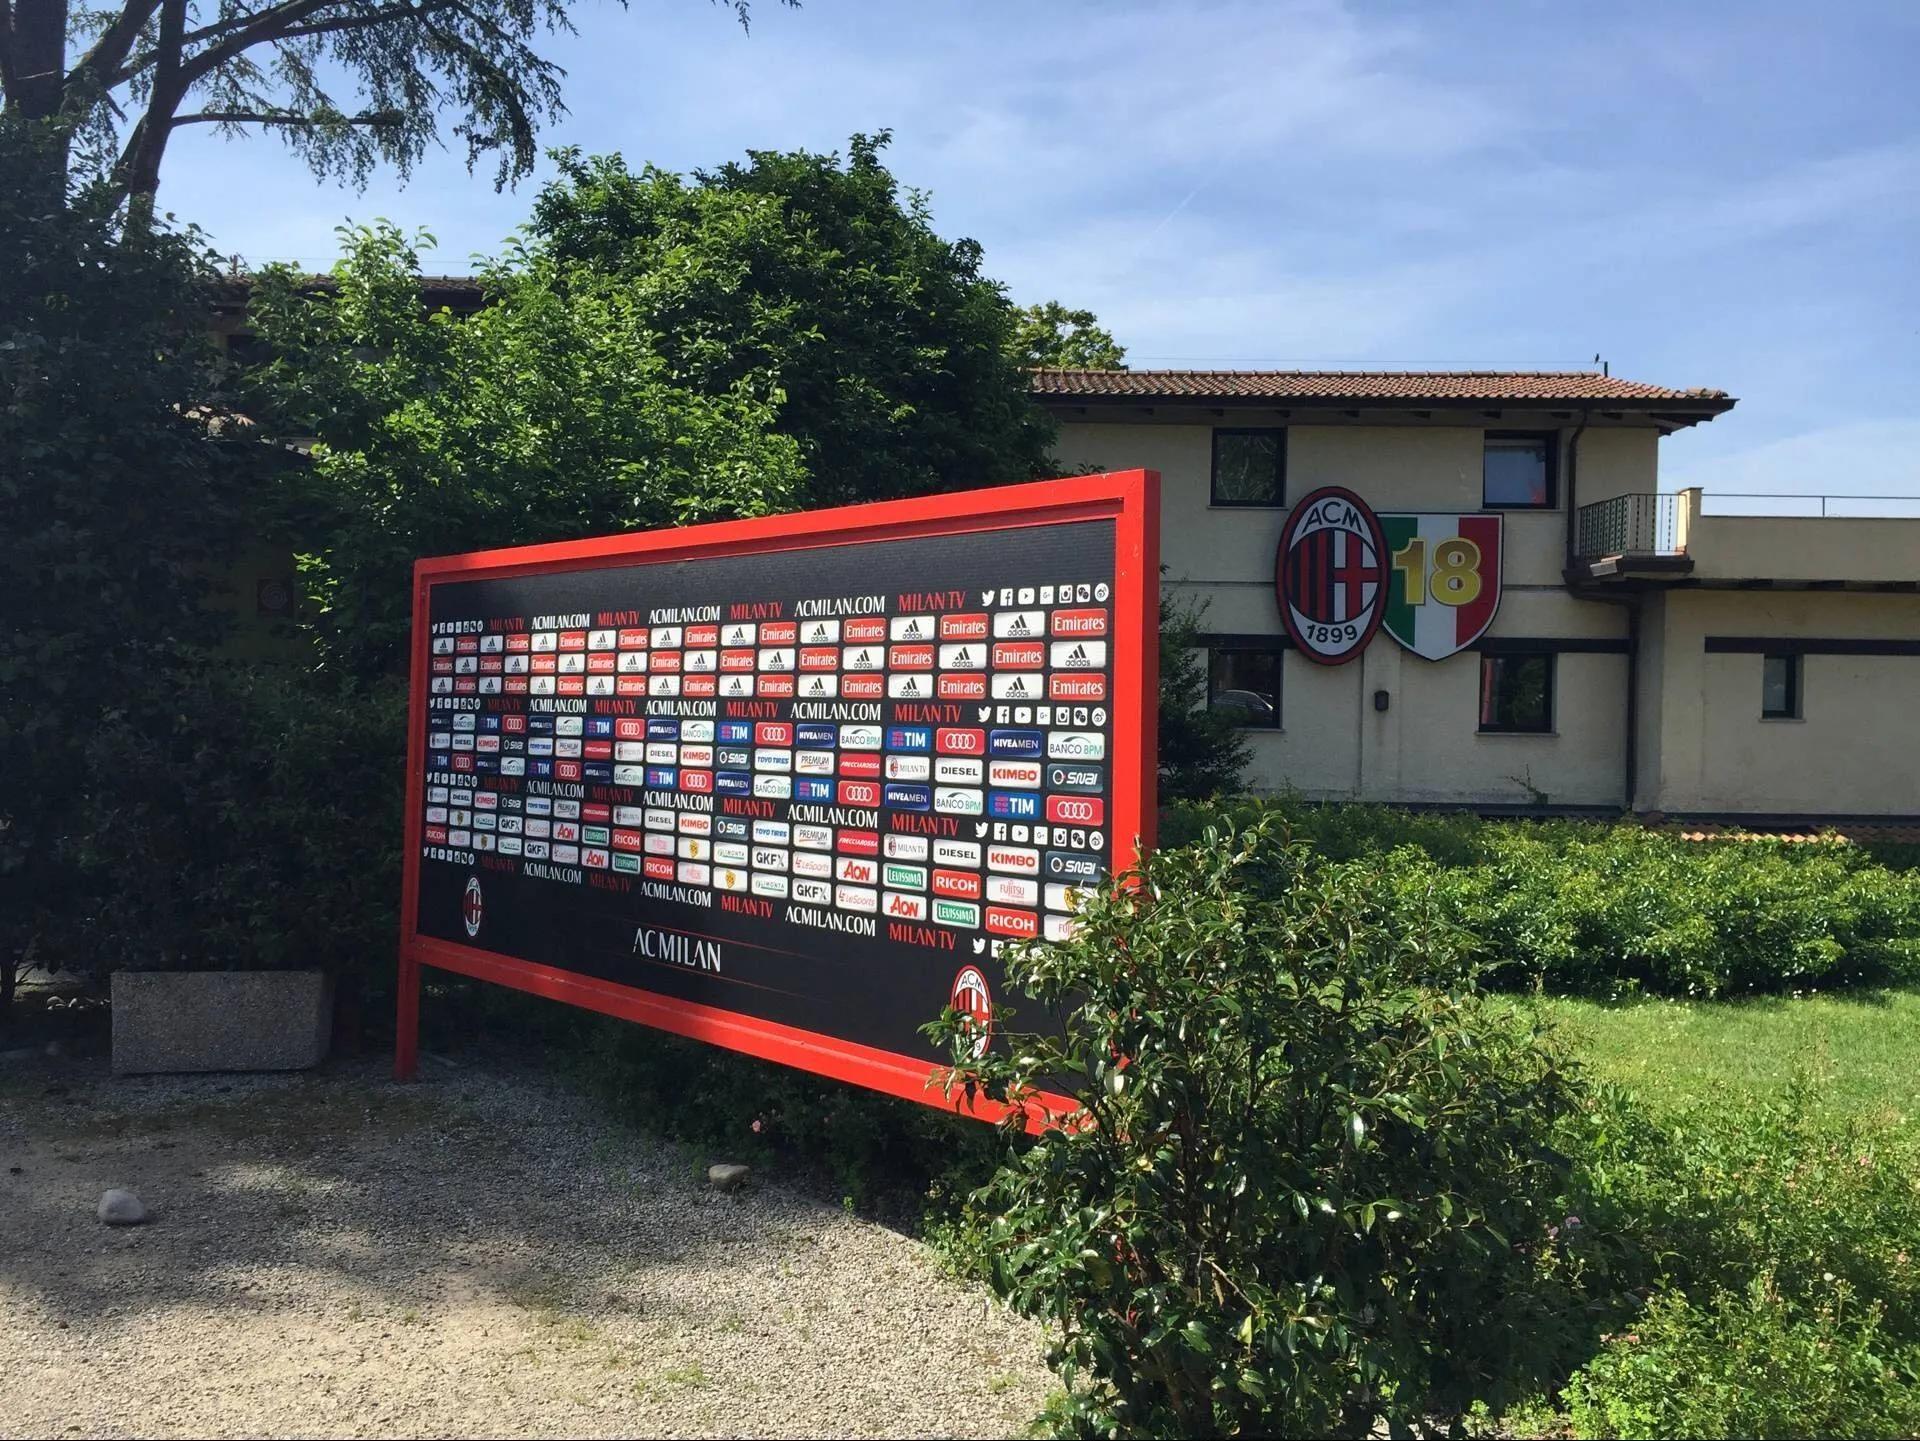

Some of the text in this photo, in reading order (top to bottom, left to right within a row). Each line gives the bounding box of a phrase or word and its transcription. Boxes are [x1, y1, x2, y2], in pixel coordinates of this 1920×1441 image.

[1301, 501, 1363, 534] ACM
[1392, 537, 1482, 606] 18
[794, 596, 885, 617] ACMILAN.COM
[648, 605, 720, 624] ACMILAN.COM
[942, 620, 986, 635] Emirates
[1054, 615, 1105, 631] Emirates
[845, 624, 884, 638] Emirates
[1007, 627, 1031, 636] adidas
[1306, 624, 1358, 644] 1899
[801, 653, 837, 666] Emirates
[891, 651, 932, 665] Emirates
[995, 649, 1043, 663] Emirates
[1065, 657, 1091, 666] adidas
[844, 680, 882, 693] Emirates
[940, 680, 984, 694] Emirates
[1005, 689, 1029, 697] adidas
[1052, 680, 1103, 695] Emirates
[645, 700, 716, 716] ACMILAN.COM
[790, 702, 881, 720] ACMILAN.COM
[731, 727, 748, 739] TIM
[904, 732, 925, 747] TIM
[1050, 743, 1102, 755] BANCO BPM
[941, 766, 978, 776] DIESEL
[992, 768, 1036, 781] KIMBO
[810, 783, 829, 798] TIM
[643, 790, 713, 812] ACMILAN.COM
[1008, 797, 1033, 814] TIM
[787, 803, 878, 828] ACMILAN.COM
[939, 847, 976, 859] DIESEL
[990, 852, 1034, 867] KIMBO
[935, 875, 978, 893] RICOH
[640, 881, 711, 909] ACMILAN.COM
[784, 904, 876, 937] ACMILAN.COM
[988, 913, 1034, 932] RICOH
[960, 972, 983, 992] ACM
